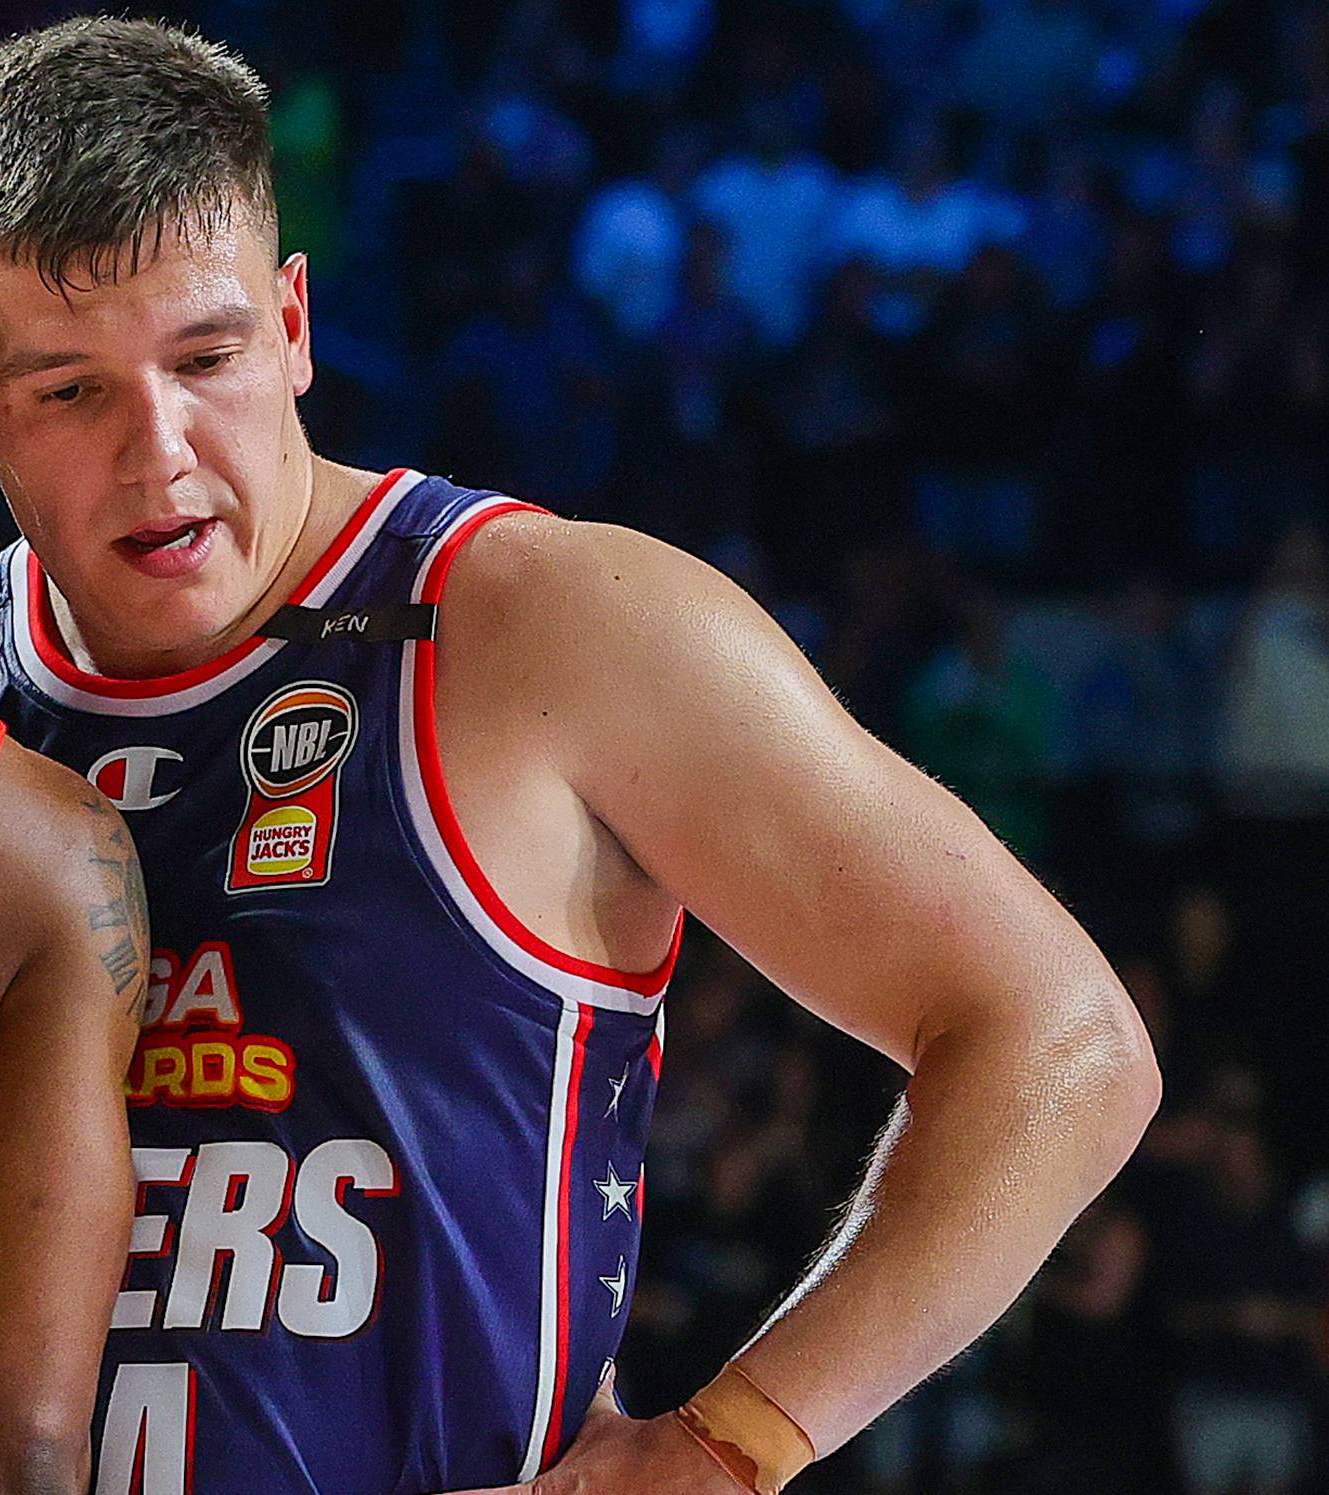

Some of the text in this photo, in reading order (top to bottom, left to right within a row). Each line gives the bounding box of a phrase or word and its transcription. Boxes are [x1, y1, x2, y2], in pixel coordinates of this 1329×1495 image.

[321, 614, 369, 638] KEN
[270, 719, 332, 773] NBL
[253, 825, 312, 842] HUNGRY
[125, 1042, 291, 1102] RDS
